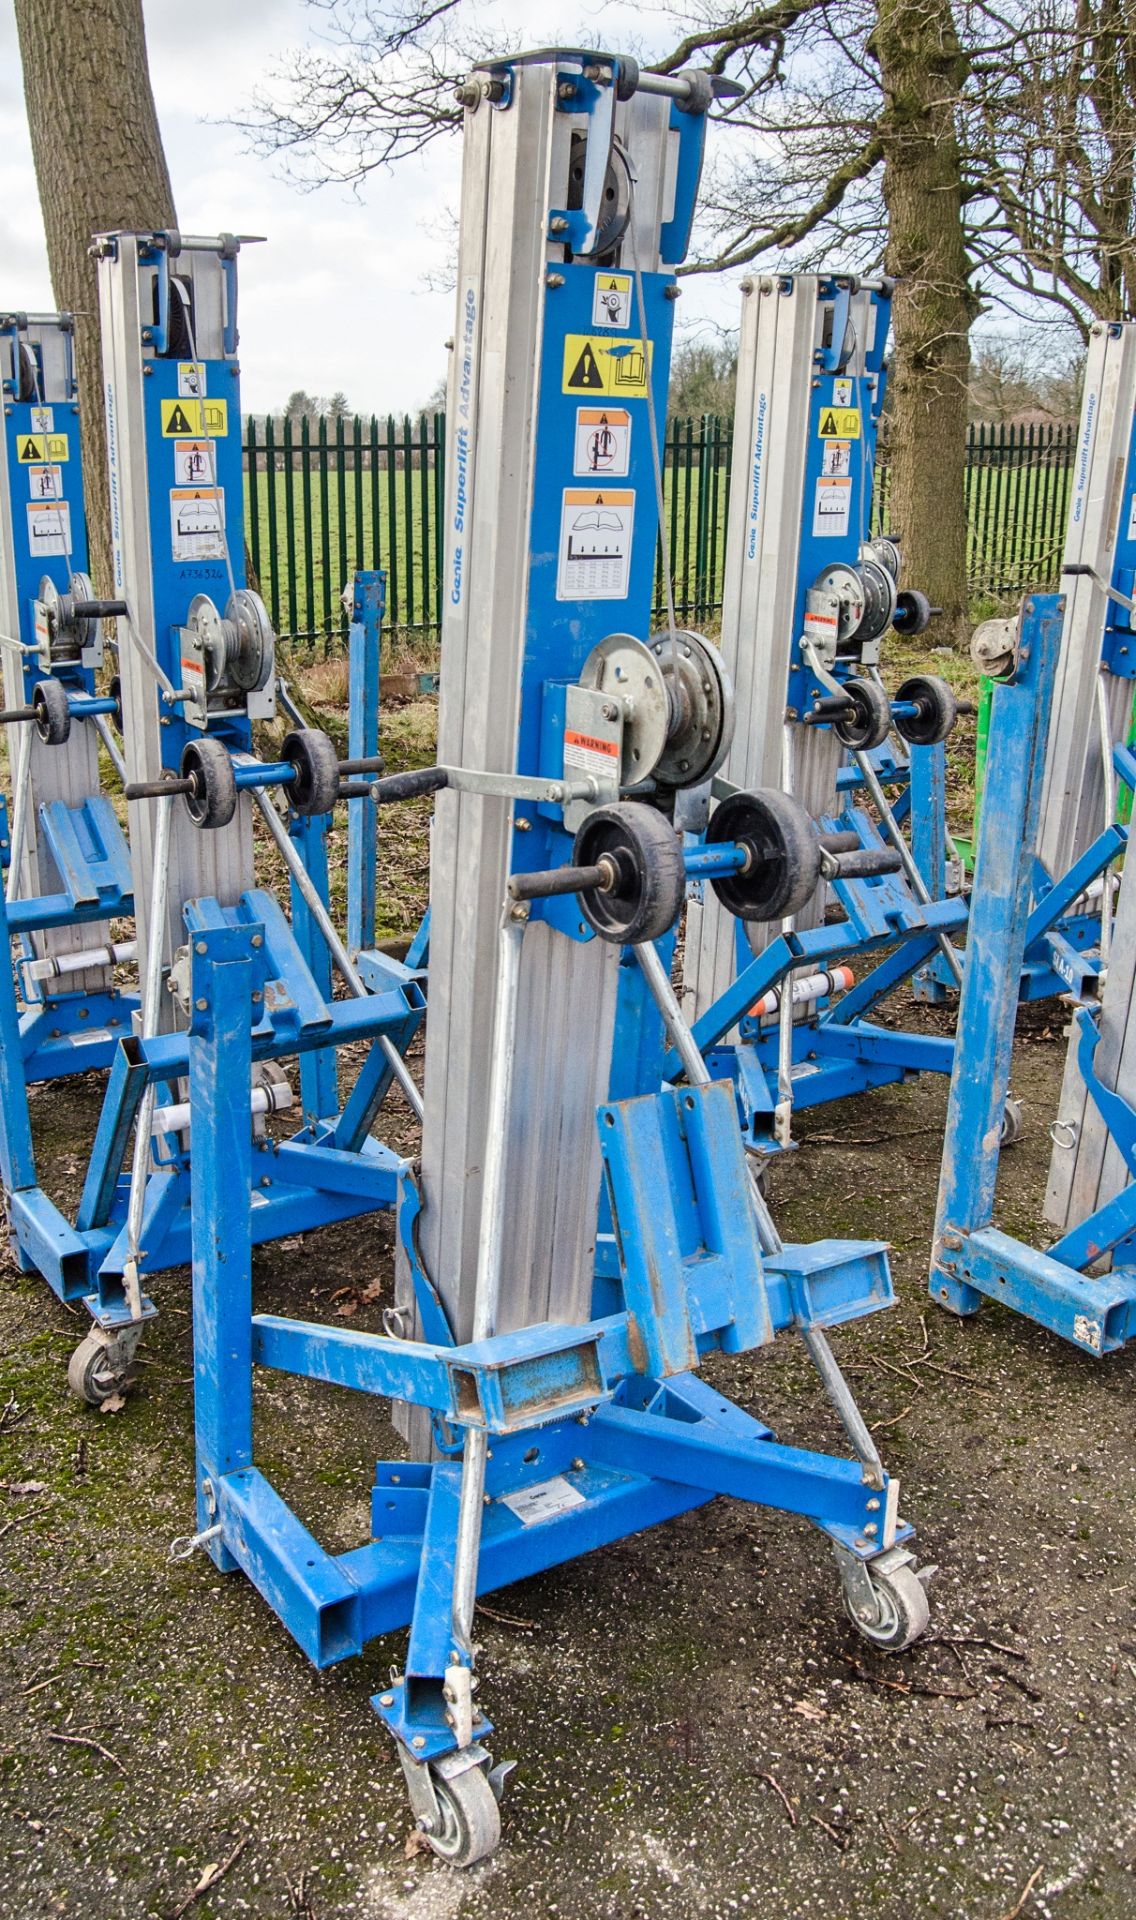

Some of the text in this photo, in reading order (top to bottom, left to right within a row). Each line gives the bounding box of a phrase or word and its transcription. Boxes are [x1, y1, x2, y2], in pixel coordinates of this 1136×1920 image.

[107, 384, 116, 466] Advantage
[451, 288, 476, 605] Genie Superlift Advantage
[748, 393, 767, 560] Genie Superlift Advantage
[1074, 393, 1095, 523] Genie Superlift Advantage
[111, 471, 121, 541] Superlift
[581, 737, 612, 753] WARNING
